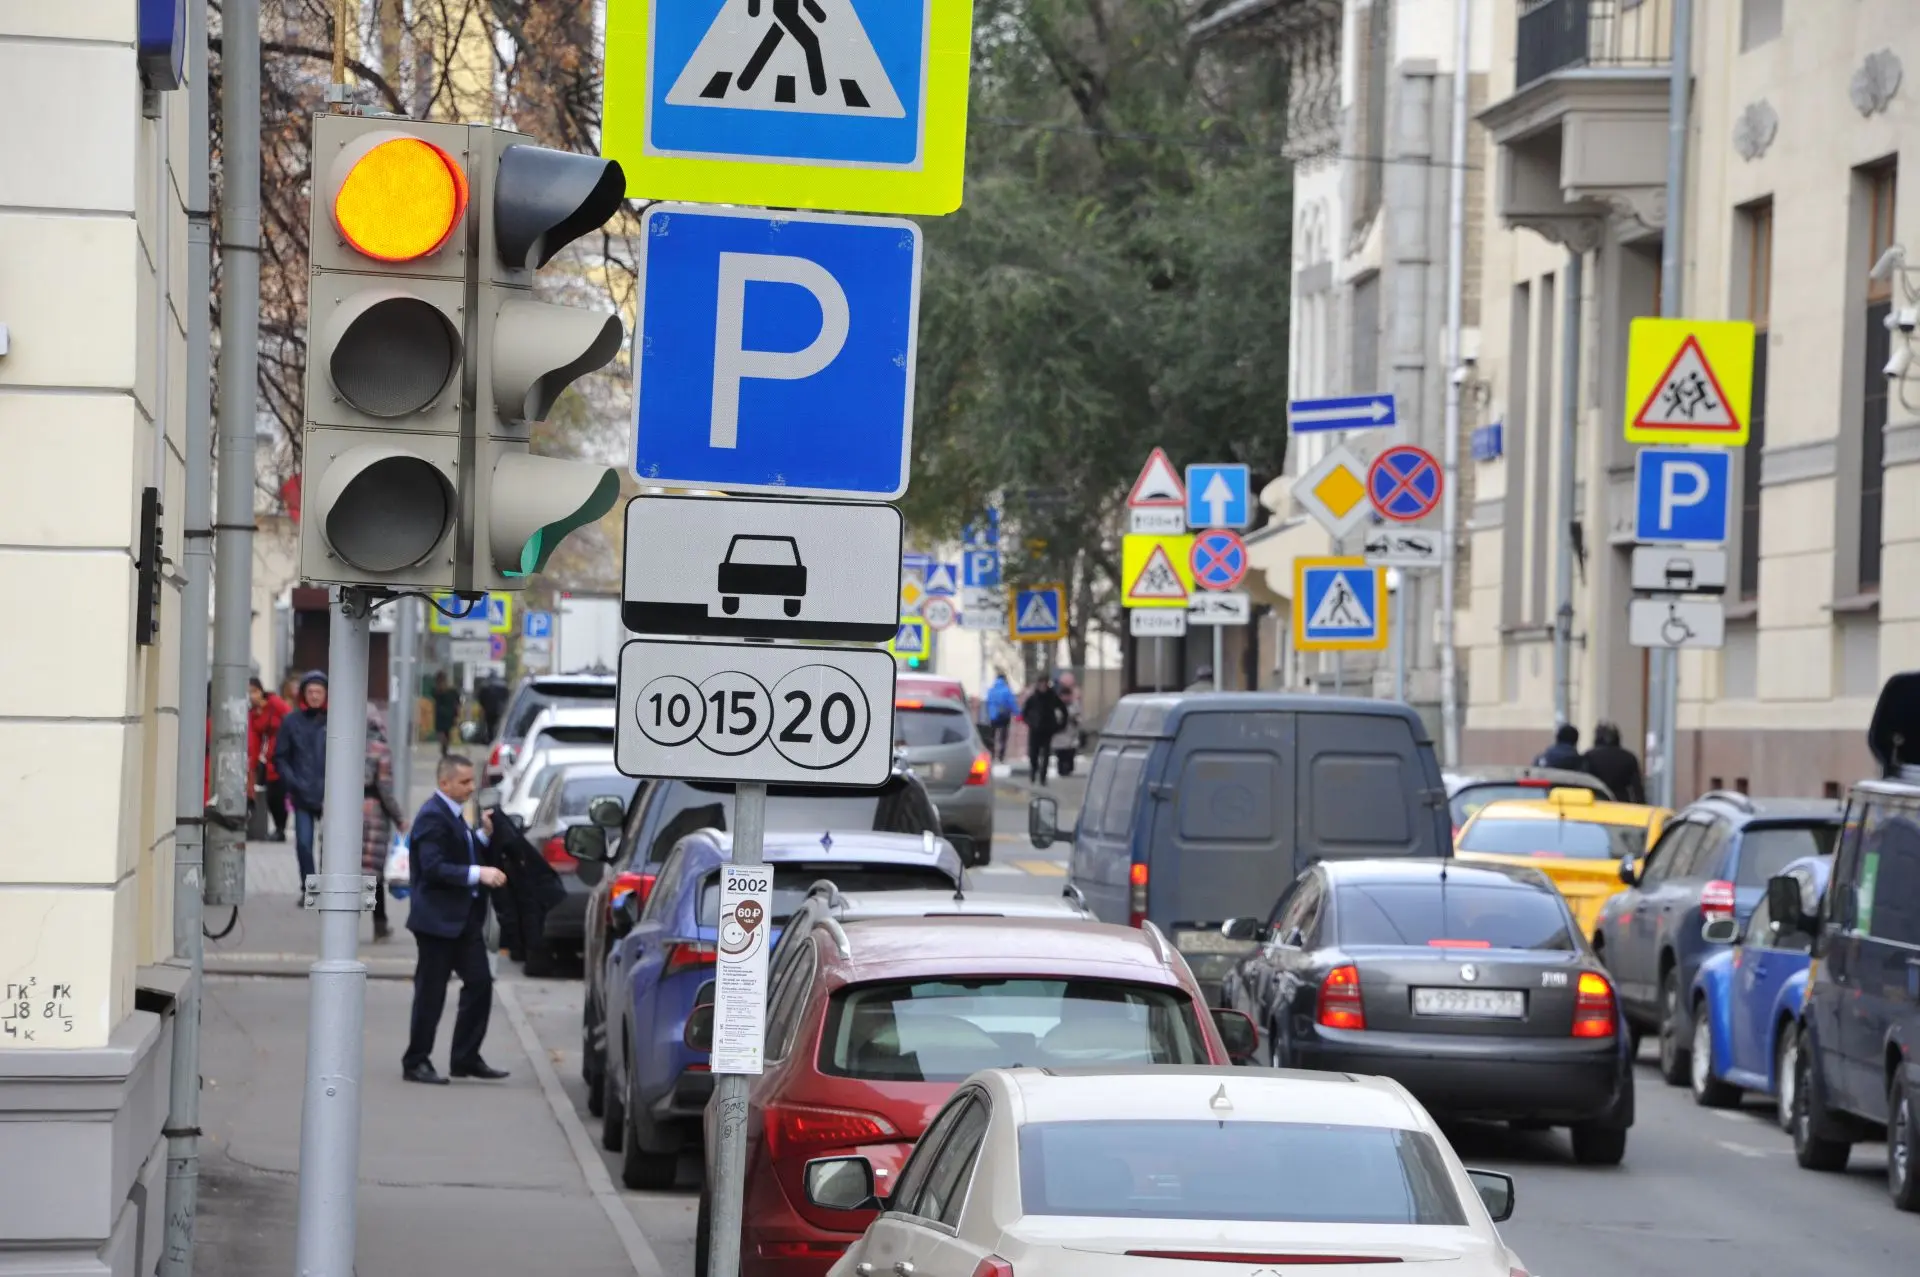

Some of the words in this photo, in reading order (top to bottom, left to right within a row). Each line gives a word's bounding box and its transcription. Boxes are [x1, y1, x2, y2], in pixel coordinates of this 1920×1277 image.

[710, 252, 850, 449] P
[1659, 461, 1710, 530] P
[972, 553, 994, 584] P
[529, 613, 548, 637] P
[649, 693, 690, 727] 10
[709, 690, 757, 735] 15
[779, 690, 856, 745] 20
[727, 878, 767, 892] 2002
